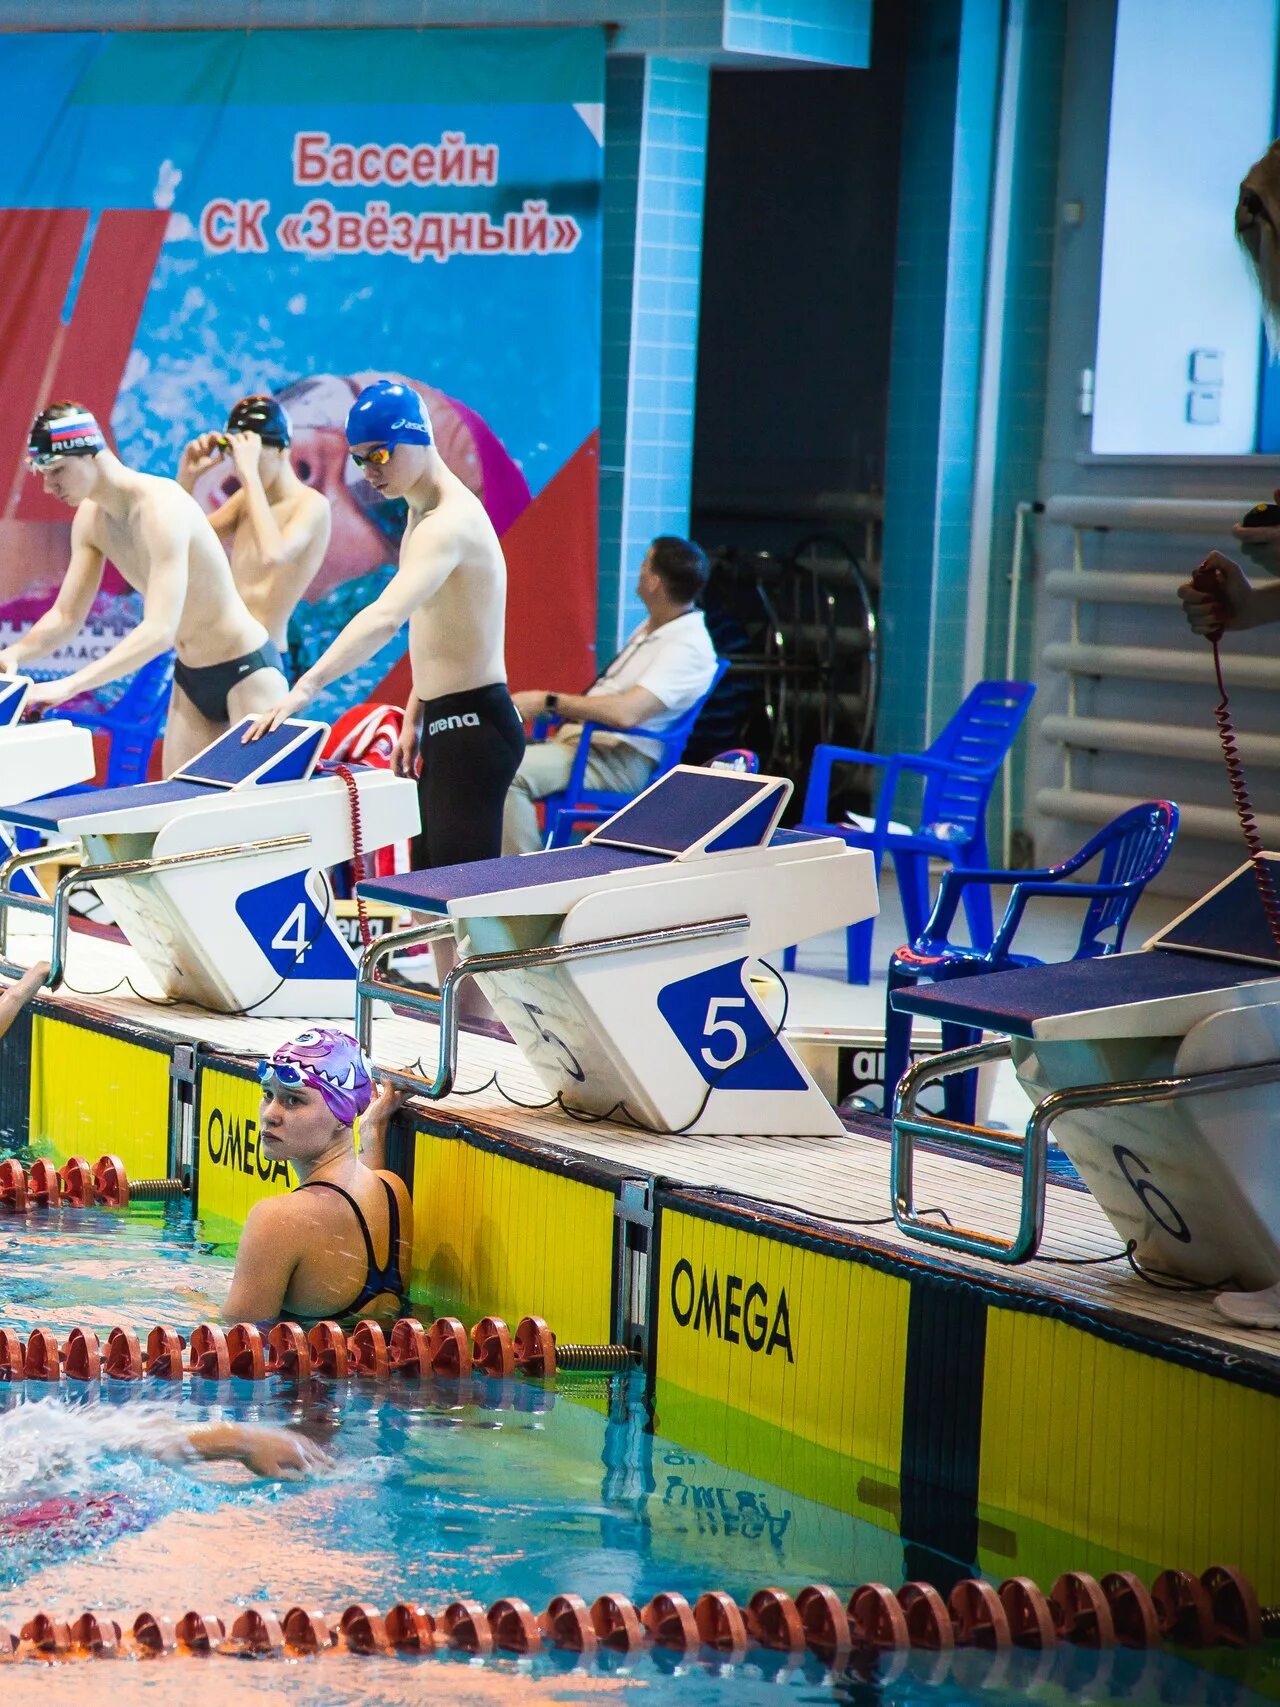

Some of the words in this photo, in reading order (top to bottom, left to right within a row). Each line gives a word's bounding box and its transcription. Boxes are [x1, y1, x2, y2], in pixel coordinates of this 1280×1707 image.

[293, 130, 499, 187] Бассейн
[200, 200, 270, 253] СК
[276, 200, 582, 264] «Звёздный»
[428, 712, 480, 736] arena
[271, 902, 313, 965] 4
[700, 997, 748, 1070] 5
[1112, 1144, 1191, 1244] 6
[670, 1257, 795, 1364] OMEGA
